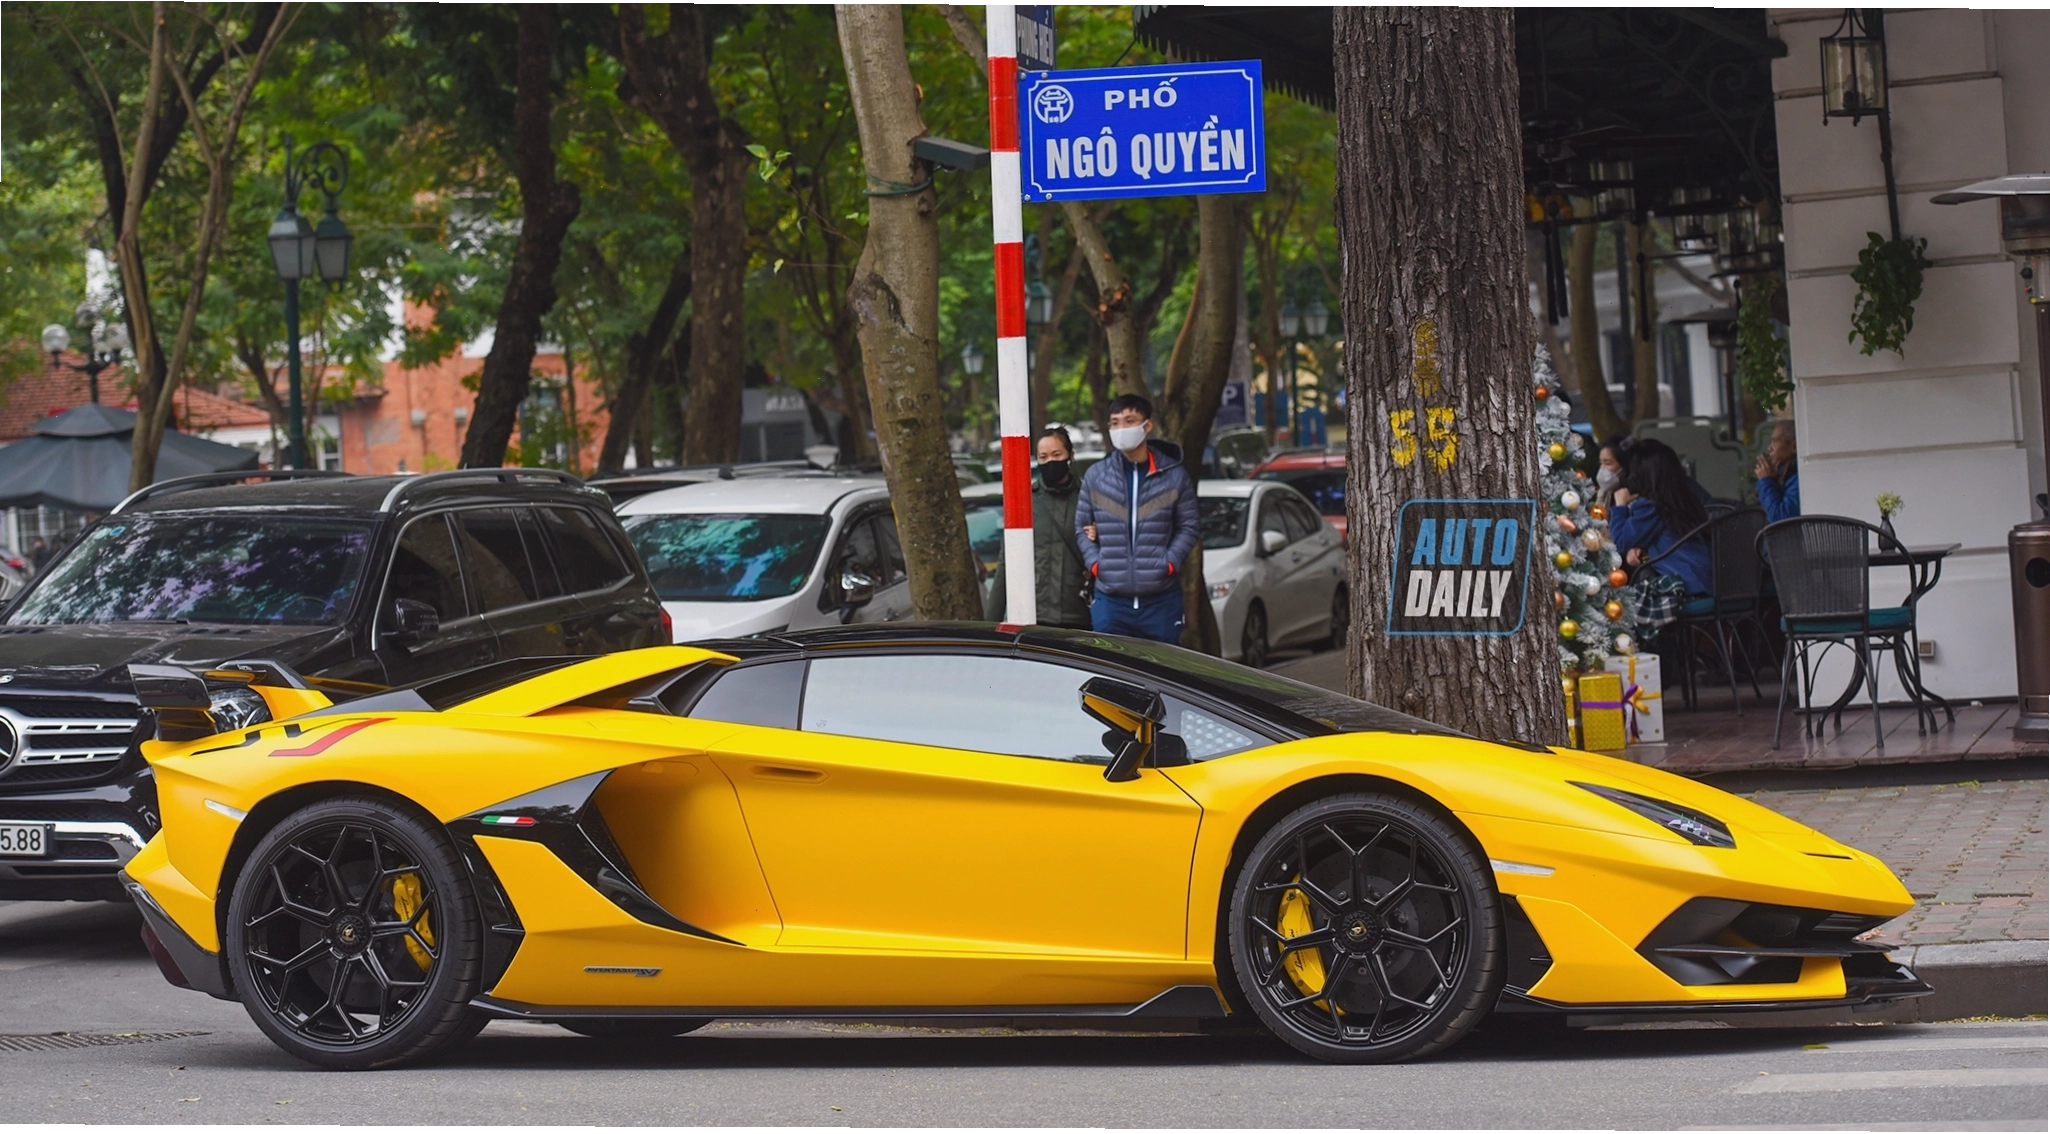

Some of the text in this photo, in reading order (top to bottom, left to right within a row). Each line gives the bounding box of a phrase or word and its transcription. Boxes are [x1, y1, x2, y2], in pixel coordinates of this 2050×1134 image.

[1104, 77, 1178, 110] PHỐ
[1046, 114, 1245, 180] NGÔ QUYỀN
[1221, 385, 1238, 406] P
